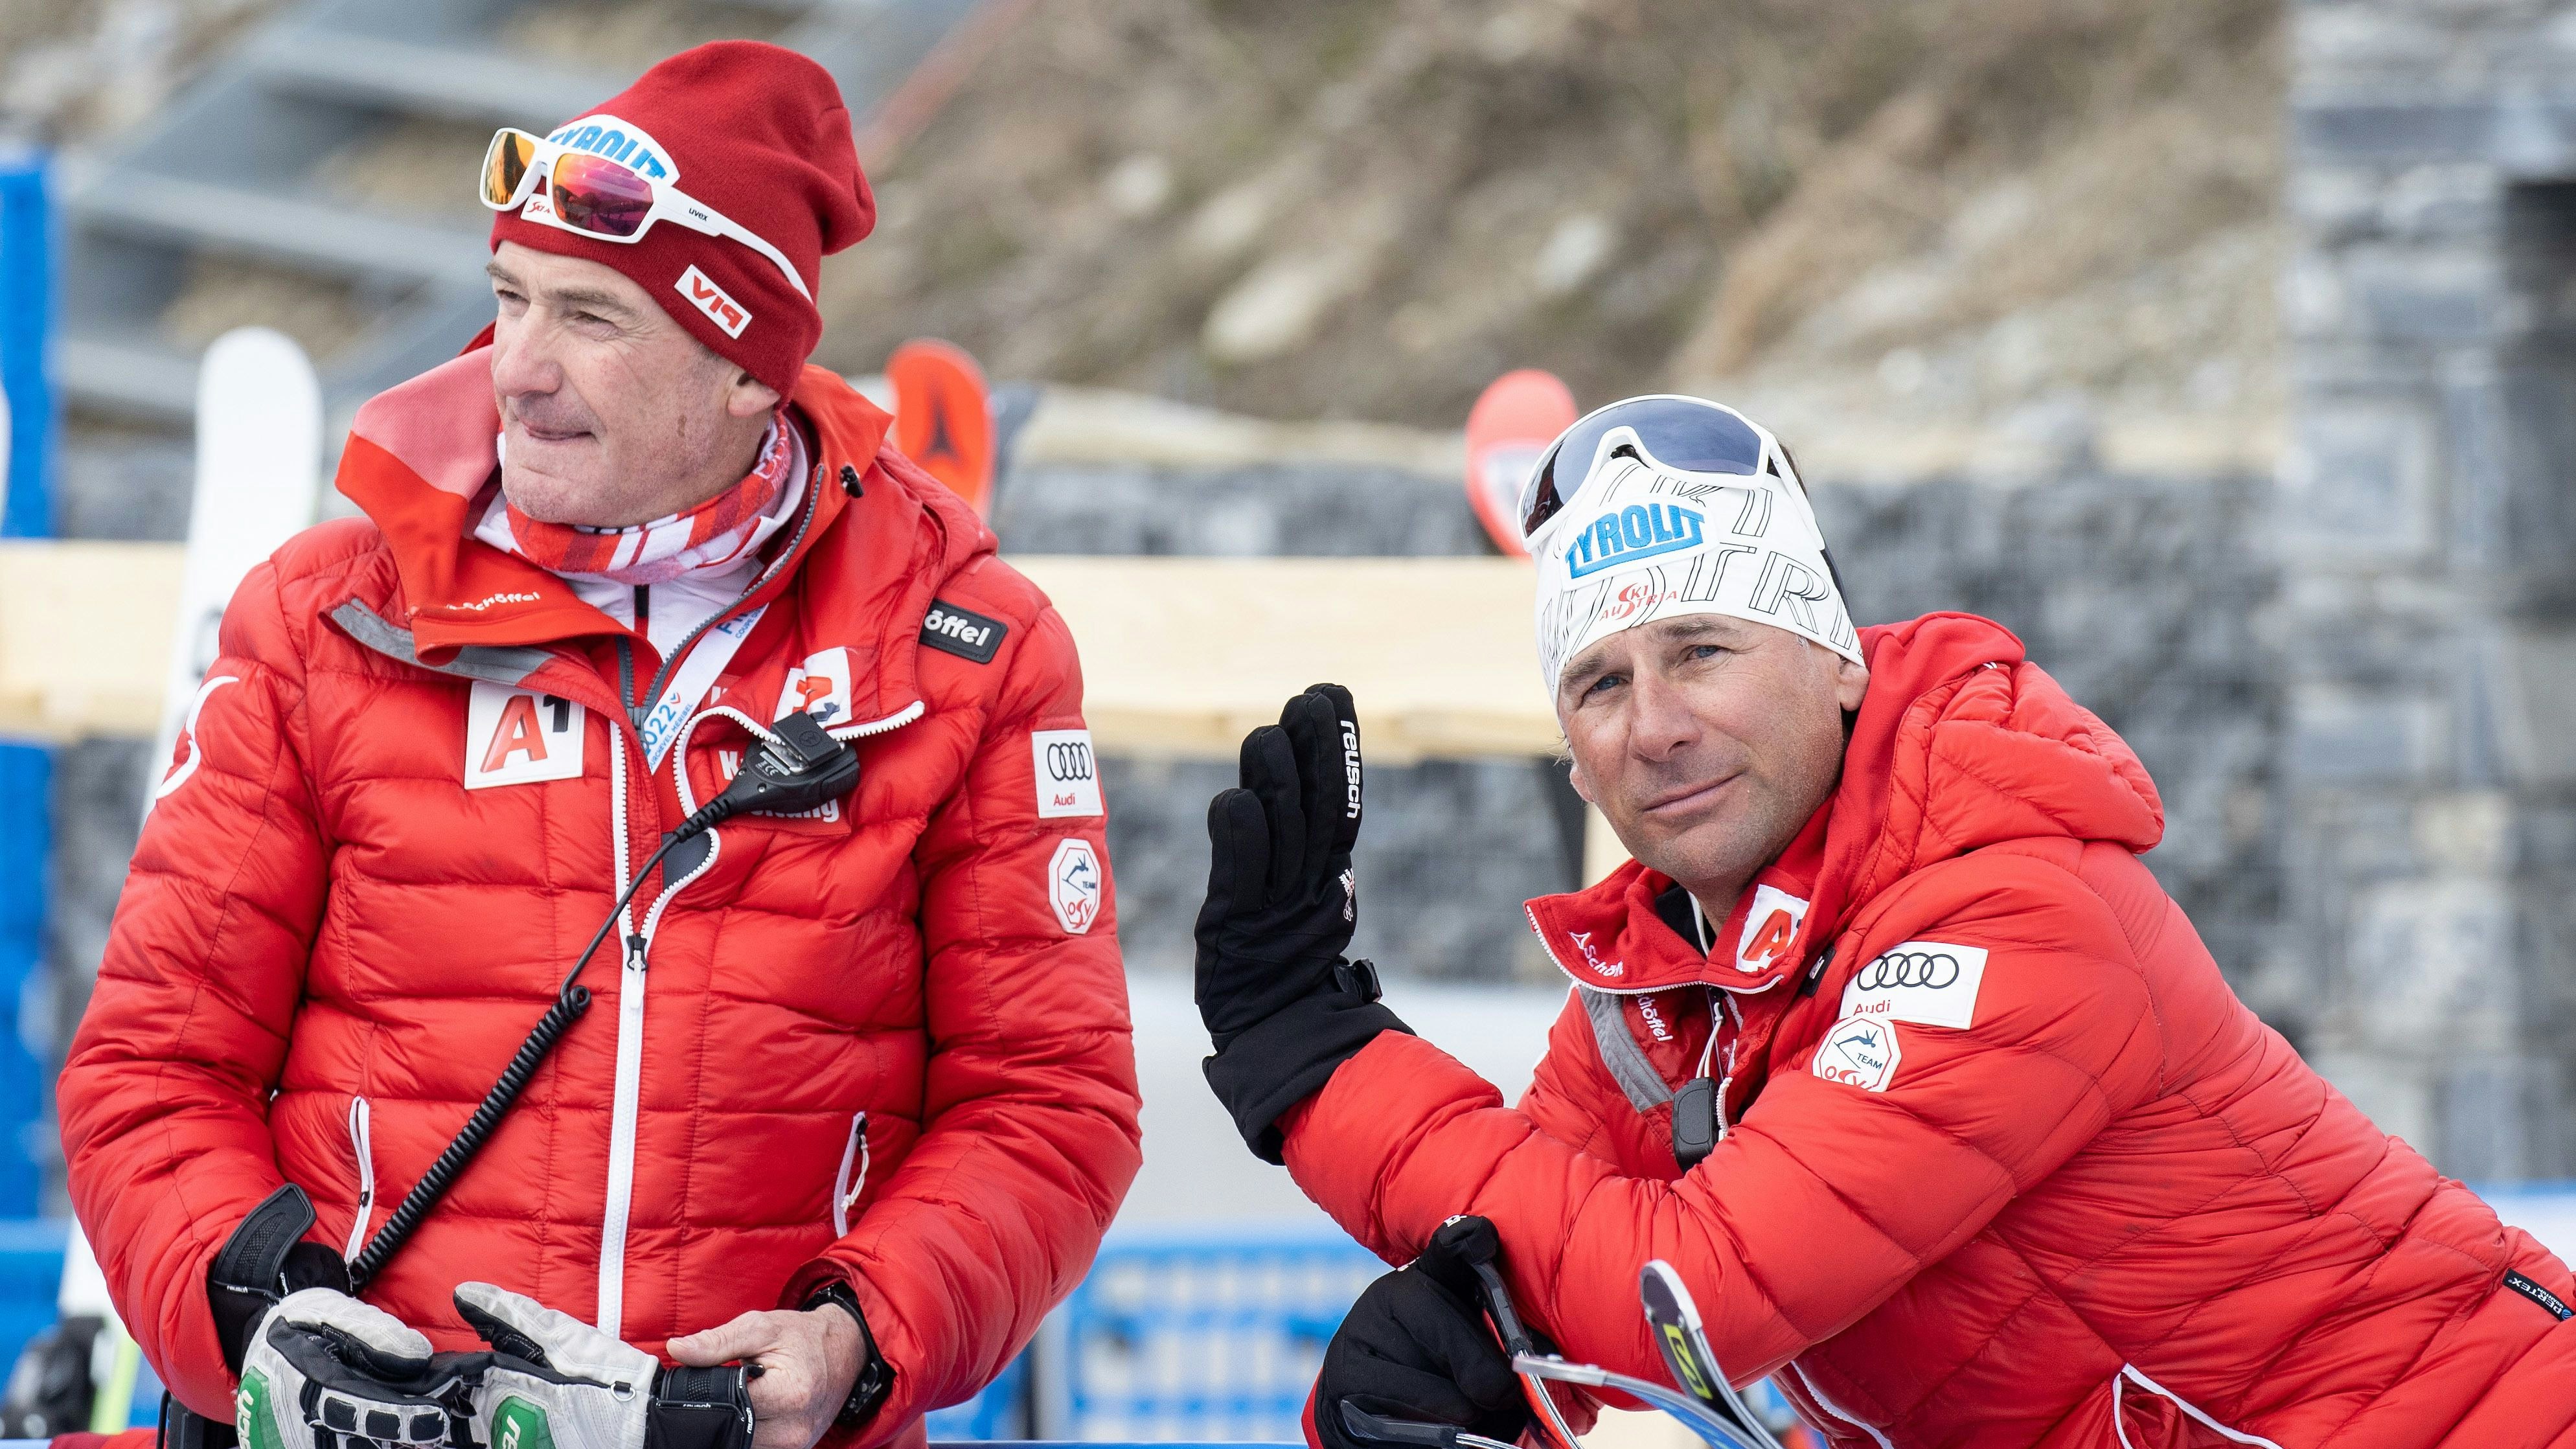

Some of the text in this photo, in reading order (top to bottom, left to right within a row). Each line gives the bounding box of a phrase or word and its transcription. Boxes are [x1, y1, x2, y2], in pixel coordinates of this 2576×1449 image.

[689, 207, 708, 222] uvex
[1565, 503, 1705, 578] TYROLIT
[924, 610, 990, 646] öffel
[480, 694, 571, 773] A1
[1340, 720, 1361, 818] reusch
[1054, 793, 1075, 806] Audi
[1082, 881, 1096, 889] TEAM
[1853, 999, 1890, 1016] Audi
[1857, 1053, 1882, 1069] TEAM
[2511, 1277, 2562, 1315] PERTEX
